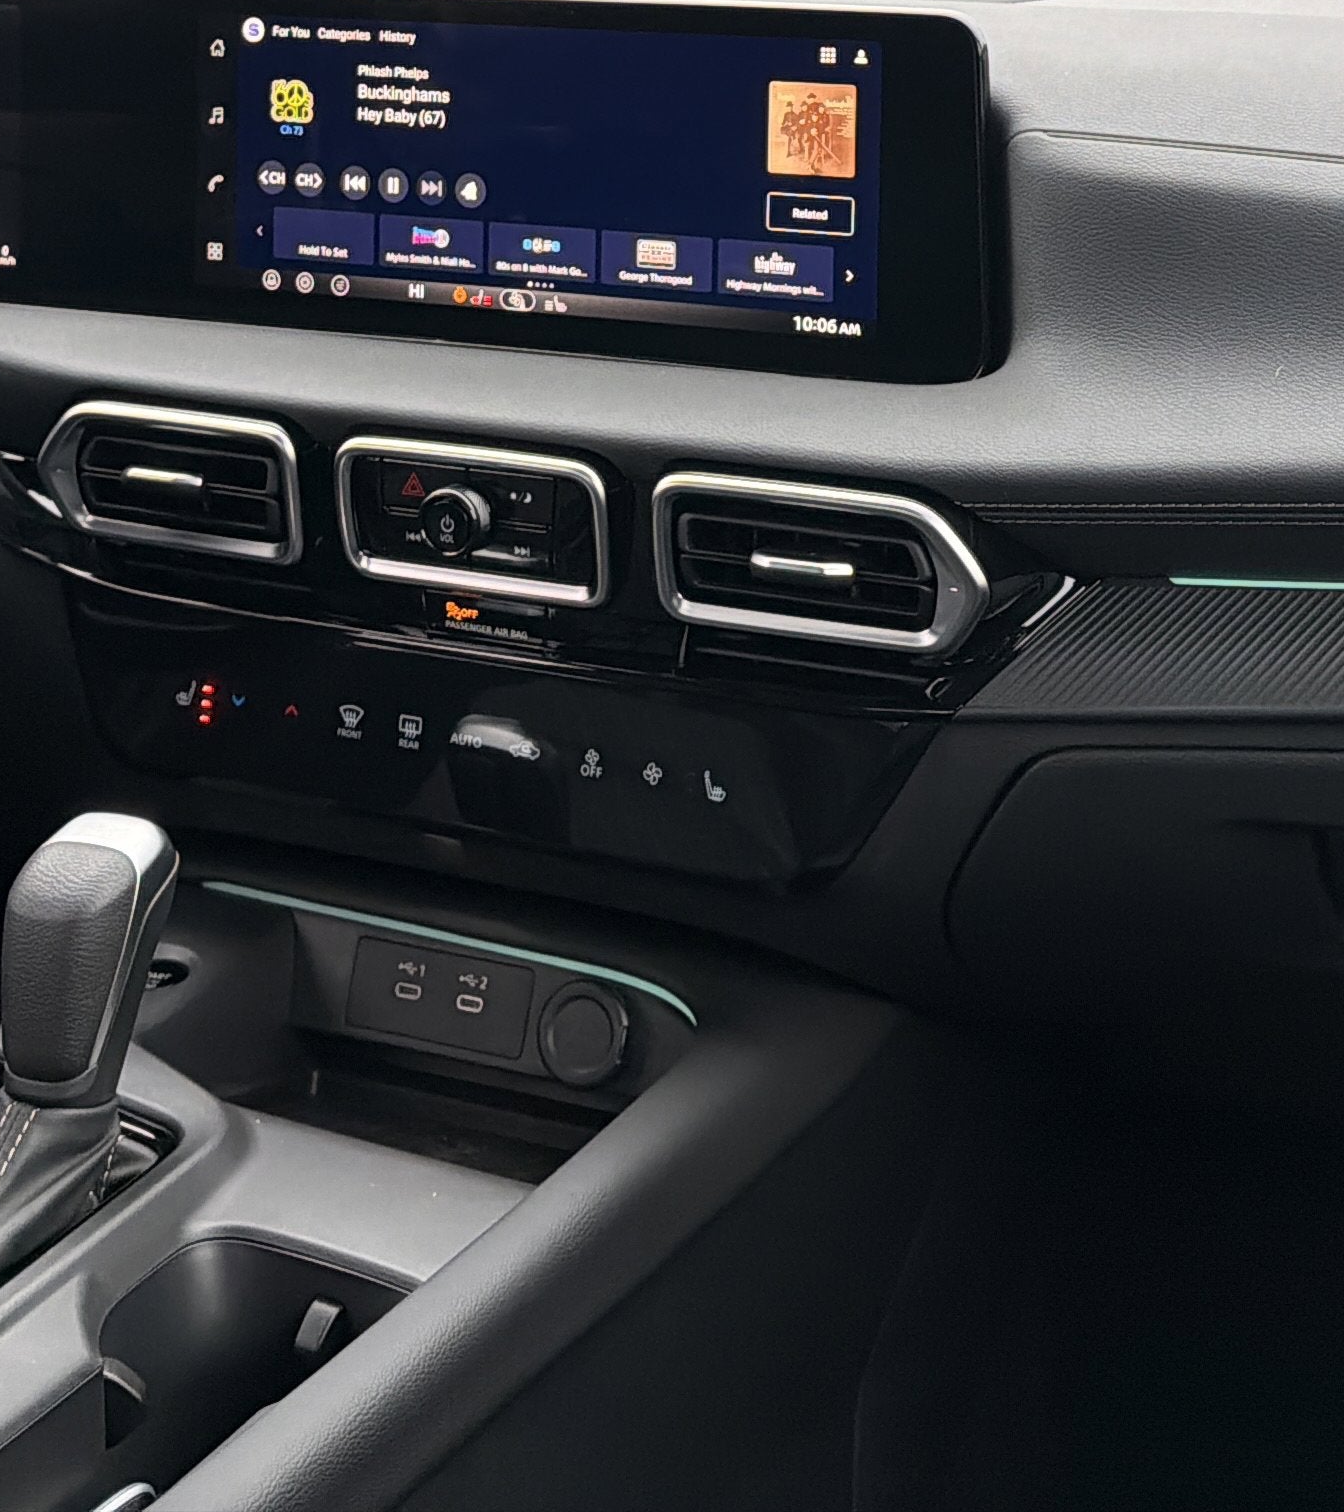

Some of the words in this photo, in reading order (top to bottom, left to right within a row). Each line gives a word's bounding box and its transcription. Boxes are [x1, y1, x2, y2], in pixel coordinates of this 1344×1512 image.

[272, 25, 288, 38] For
[290, 26, 311, 39] You
[317, 27, 371, 43] Categories
[379, 30, 416, 45] History
[394, 66, 429, 81] Phelps
[358, 84, 450, 104] Buckinghams
[357, 107, 383, 125] Hey
[384, 108, 417, 127] Baby
[419, 110, 447, 128] (67)
[792, 208, 829, 221] Related
[298, 245, 320, 256] Hold
[321, 246, 332, 257] To
[333, 247, 349, 259] Set
[754, 256, 796, 275] highway
[619, 271, 648, 283] George
[409, 283, 425, 299] HI
[726, 279, 762, 292] Highway
[763, 282, 801, 296] Mornings
[793, 316, 838, 334] 10:06
[839, 322, 862, 336] AM
[440, 533, 455, 544] VOL
[461, 608, 479, 619] OFF
[445, 620, 493, 635] PASSENGER
[494, 627, 508, 638] AIR
[510, 629, 528, 640] BAG
[336, 728, 362, 740] FRONT
[449, 732, 483, 749] AUTO
[398, 738, 419, 750] REAR
[580, 764, 603, 779] OFF
[419, 964, 426, 977] 1
[479, 976, 488, 989] 2
